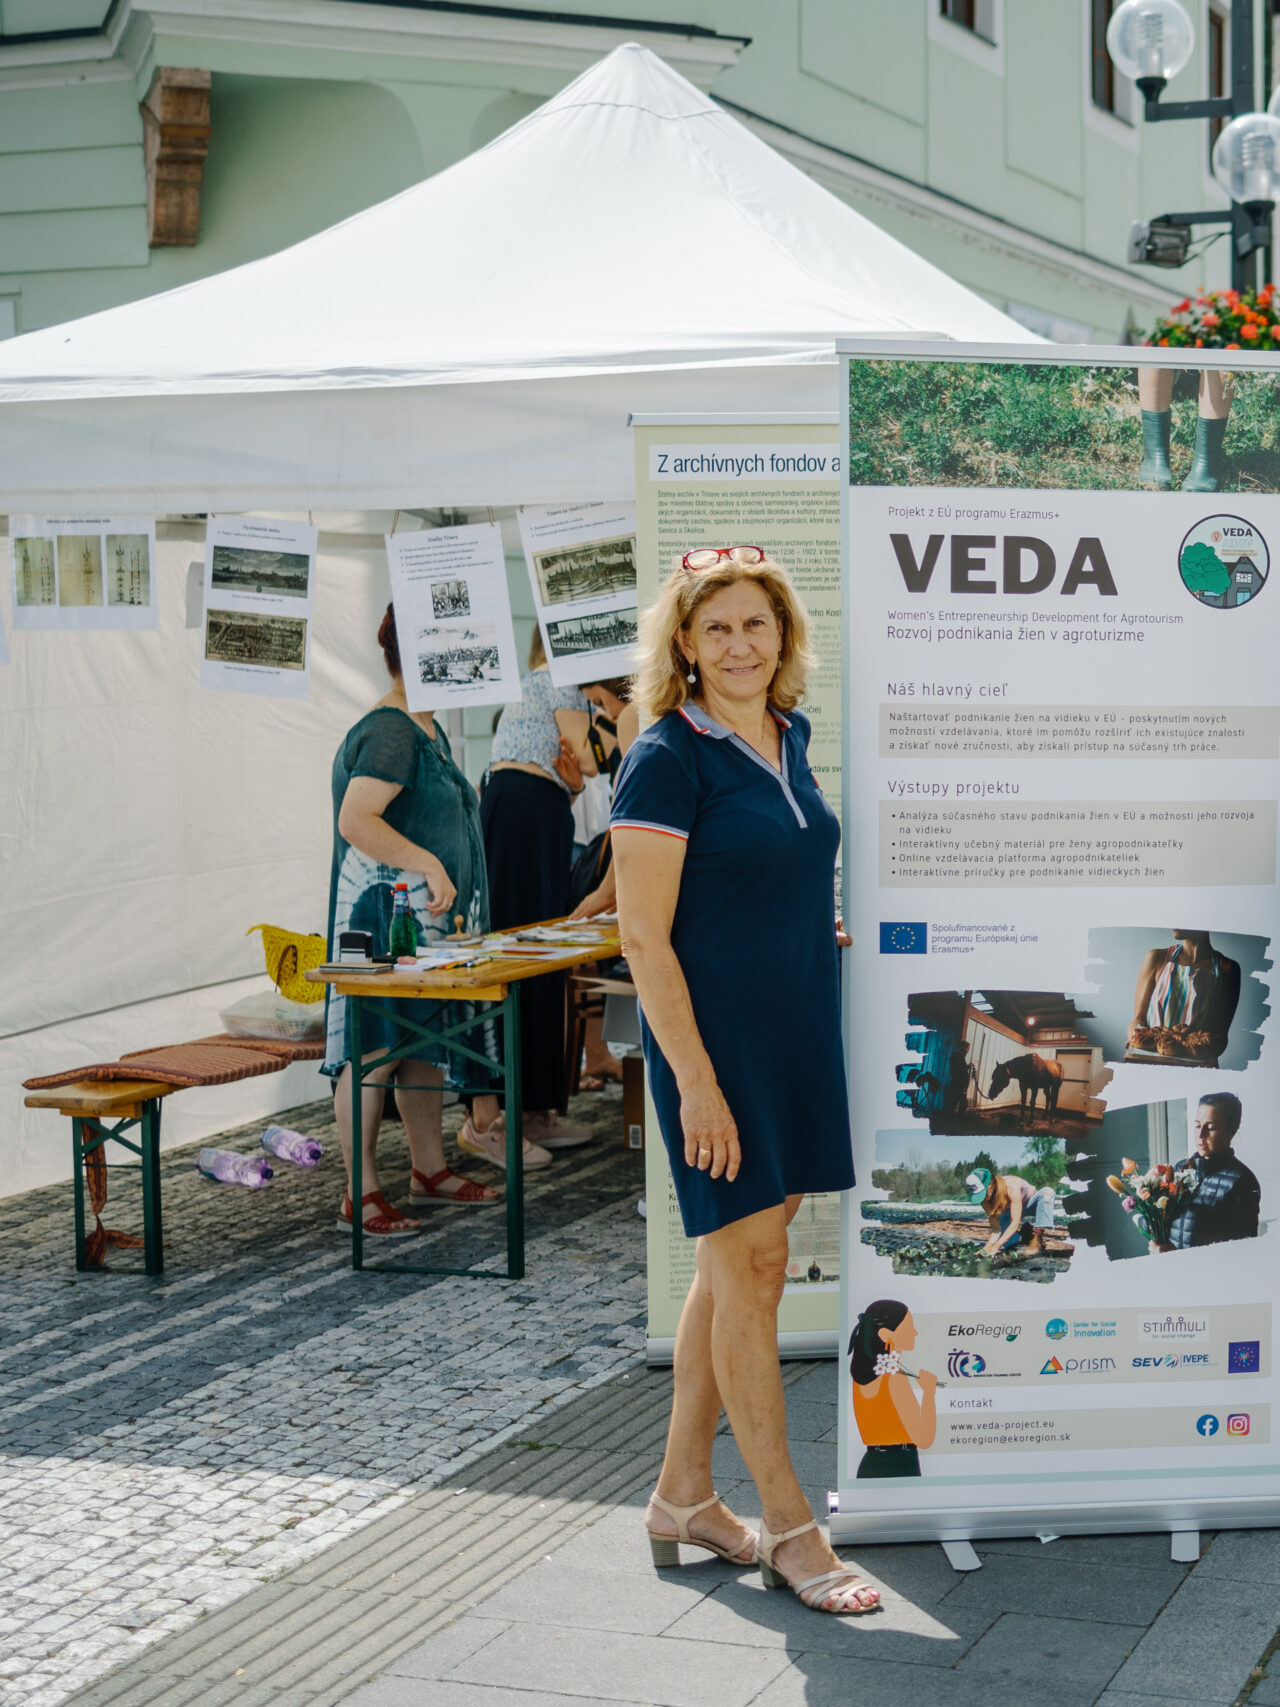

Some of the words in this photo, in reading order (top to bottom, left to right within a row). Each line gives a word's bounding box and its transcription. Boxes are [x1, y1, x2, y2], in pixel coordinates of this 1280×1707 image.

[657, 454, 668, 472] Z
[673, 453, 764, 476] archívnych
[770, 453, 826, 472] fondov
[831, 457, 840, 472] a
[888, 506, 925, 519] Projekt
[928, 508, 934, 517] z
[937, 504, 951, 517] EÚ
[955, 509, 1006, 520] programu
[1010, 508, 1059, 520] Erasmus+
[1222, 528, 1253, 536] VEDA
[890, 533, 1118, 596] VEDA
[887, 609, 934, 620] Women's
[938, 610, 1028, 624] Entrepreneurship
[1032, 611, 1099, 624] Development
[1102, 612, 1116, 623] for
[1120, 612, 1183, 625] Agrotourism
[887, 625, 932, 642] Rozvoj
[937, 626, 1012, 642] podnikania
[1018, 626, 1044, 640] žien
[1050, 630, 1057, 640] v
[1062, 628, 1144, 644] agroturizme
[887, 682, 915, 696] Náš
[922, 682, 972, 699] hlavný
[801, 705, 822, 714] ročie)
[889, 712, 950, 721] Naštartovať
[954, 712, 1010, 723] podnikanie
[1014, 712, 1034, 722] žien
[1054, 713, 1090, 722] vidieku
[1128, 714, 1189, 725] poskytnutím
[1193, 714, 1226, 725] nových
[810, 765, 830, 773] dáva
[887, 780, 949, 796] Výstupy
[956, 780, 1019, 797] projektu
[898, 810, 938, 822] Analýza
[942, 811, 996, 820] súčasného
[1000, 812, 1027, 820] stavu
[1031, 811, 1085, 822] podnikania
[1089, 810, 1109, 820] žien
[1196, 811, 1216, 822] jeho
[1220, 810, 1254, 821] rozvoja
[899, 826, 910, 834] na
[915, 825, 951, 834] vidieku
[899, 839, 960, 850] Interaktívny
[964, 839, 1000, 850] učebný
[1004, 839, 1044, 848] materiál
[1049, 840, 1064, 850] pre
[1068, 839, 1091, 849] ženy
[1095, 839, 1183, 850] agropodnikateľky
[898, 853, 931, 862] Online
[998, 853, 1046, 864] platforma
[1050, 852, 1139, 864] agropodnikateliek
[899, 867, 960, 876] Interaktívne
[964, 867, 1005, 878] príručky
[1009, 869, 1026, 878] pre
[1029, 867, 1083, 878] podnikanie
[1088, 866, 1140, 878] vidieckych
[1144, 866, 1164, 876] žien
[948, 1324, 1022, 1338] EkoRegion
[1074, 1329, 1116, 1337] Innovation
[1132, 1358, 1164, 1368] SEV
[1182, 1354, 1209, 1363] IVEPE
[1066, 1357, 1116, 1374] prism
[949, 1398, 992, 1408] Kontakt
[950, 1420, 1054, 1431] www.veda-project.eu
[950, 1432, 1070, 1445] ekoregion@ekoregion.sk
